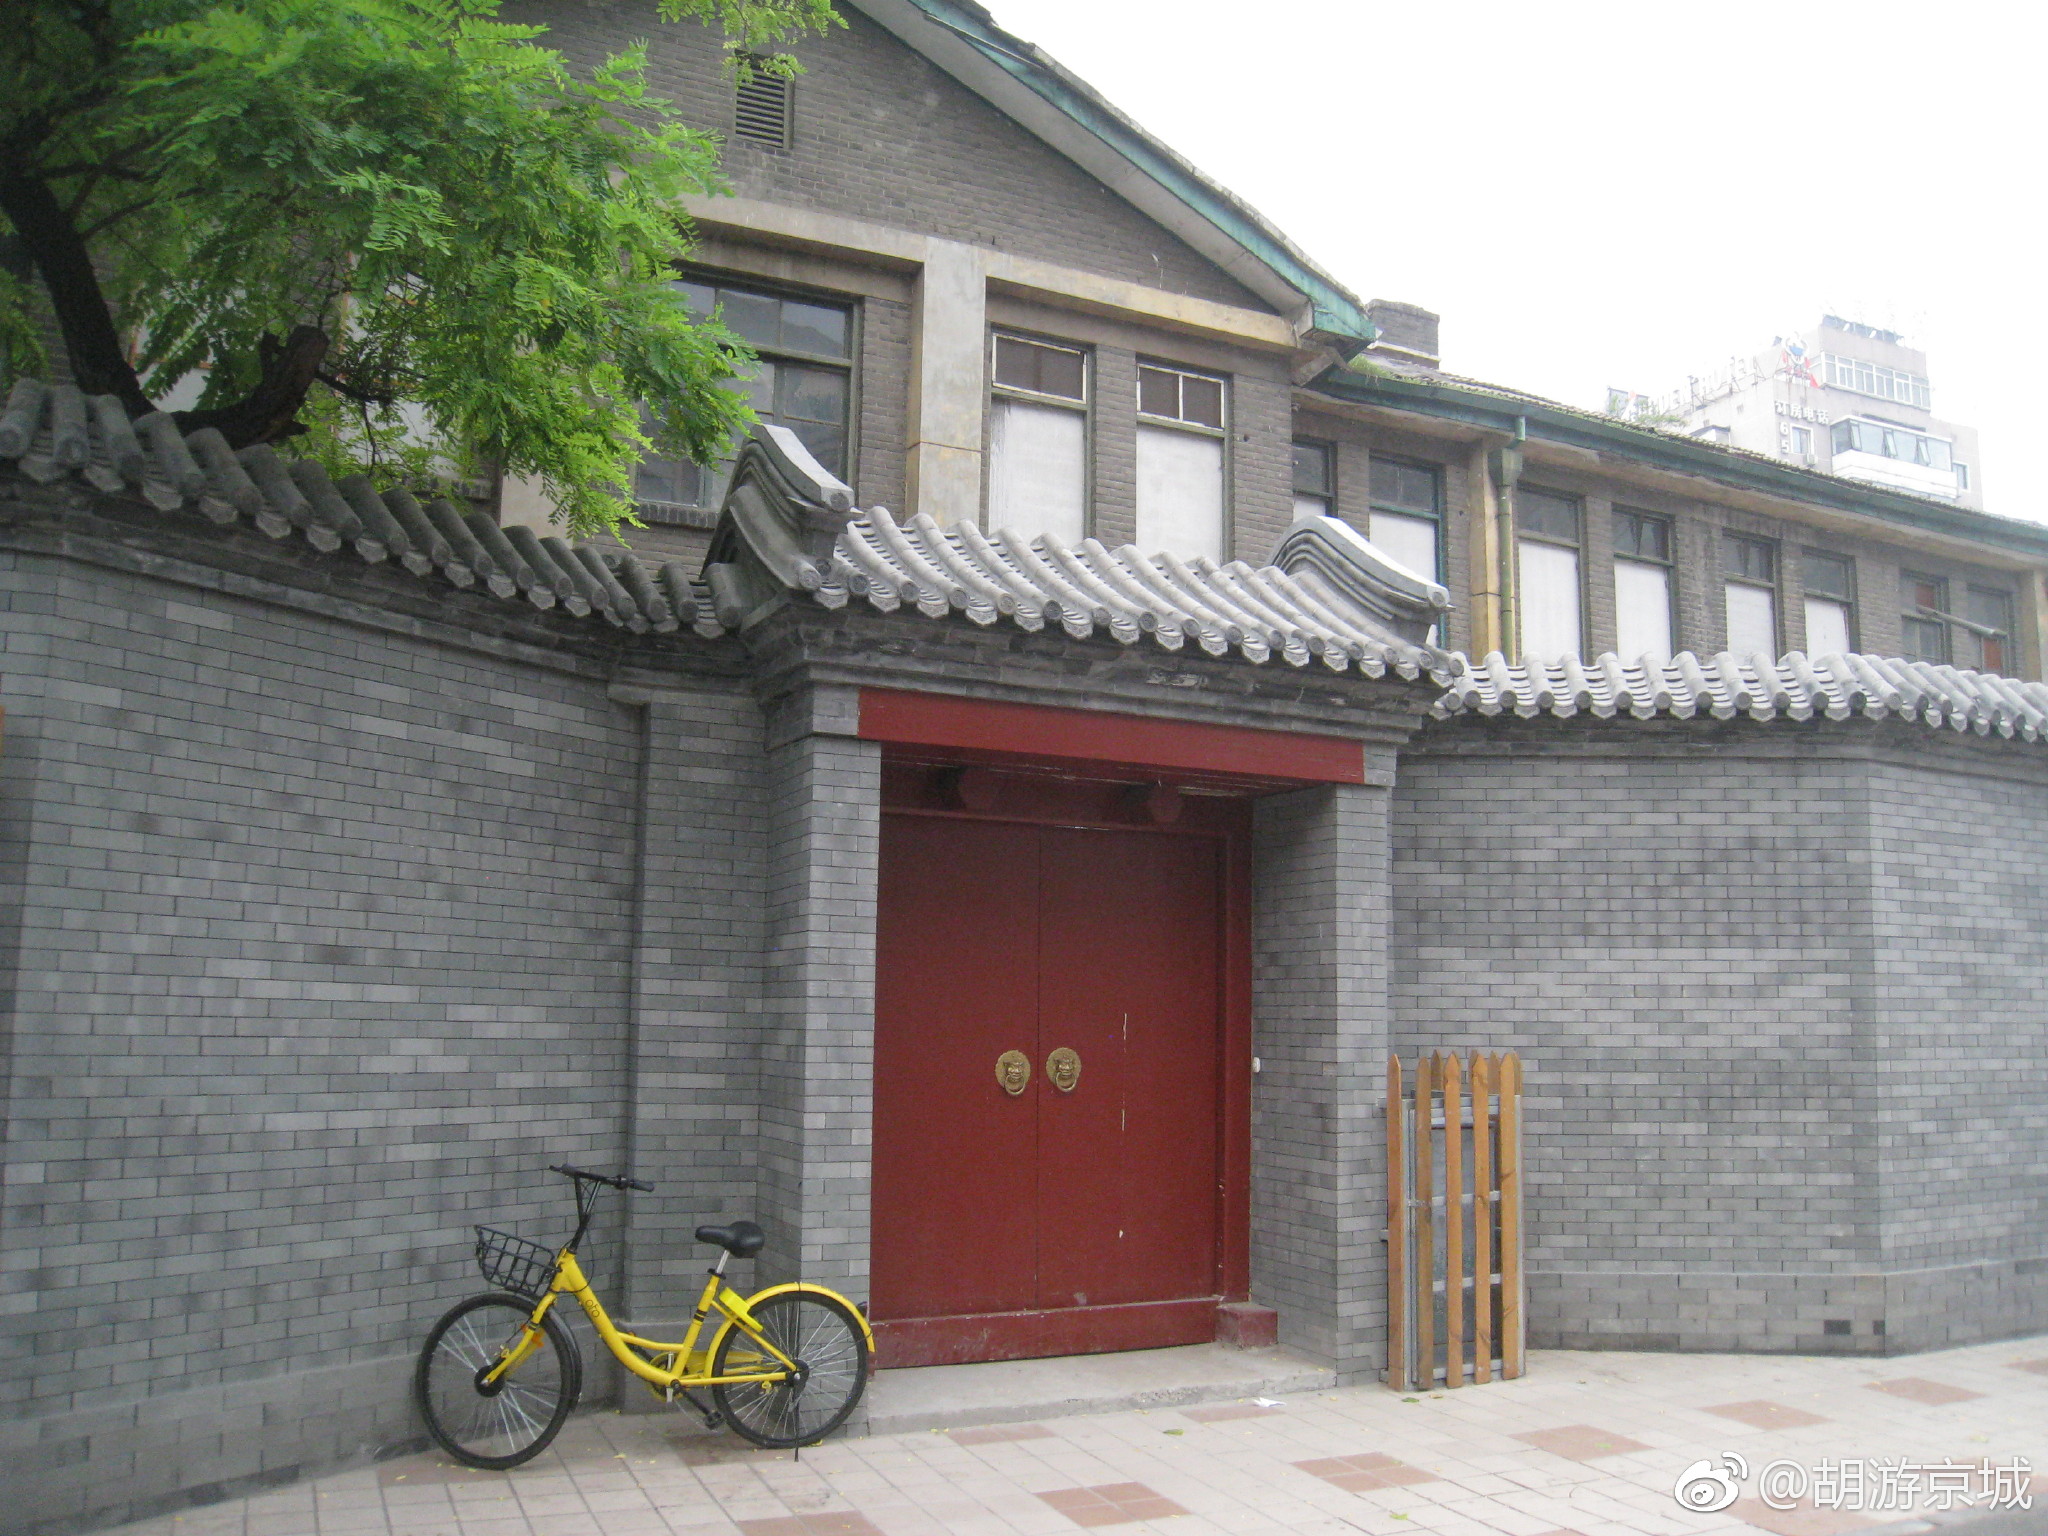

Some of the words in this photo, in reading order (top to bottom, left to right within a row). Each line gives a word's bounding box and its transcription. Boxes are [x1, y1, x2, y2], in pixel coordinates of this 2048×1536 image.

[1775, 400, 1829, 425] 订房电话
[585, 1300, 600, 1317] ofo
